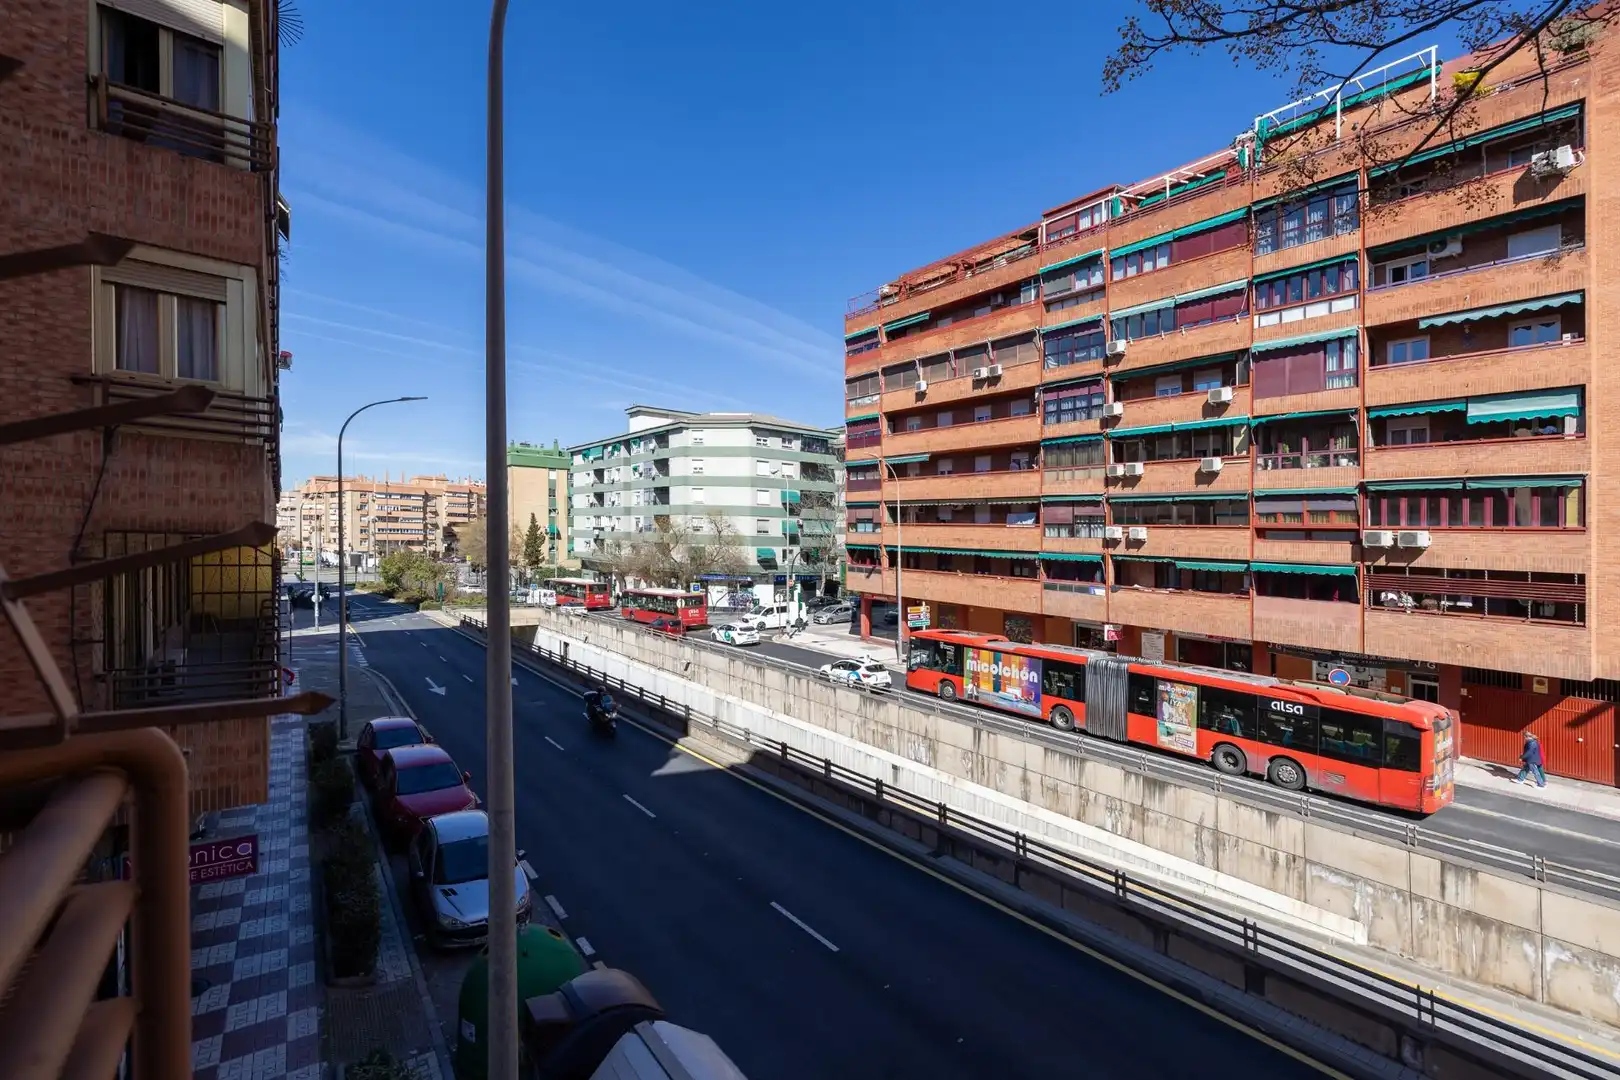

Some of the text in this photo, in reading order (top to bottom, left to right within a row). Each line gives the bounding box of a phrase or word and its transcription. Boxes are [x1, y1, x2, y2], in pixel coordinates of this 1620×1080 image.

[966, 659, 1038, 684] micolchón
[1271, 700, 1304, 715] alsa
[200, 860, 254, 879] ESTÉTICA
